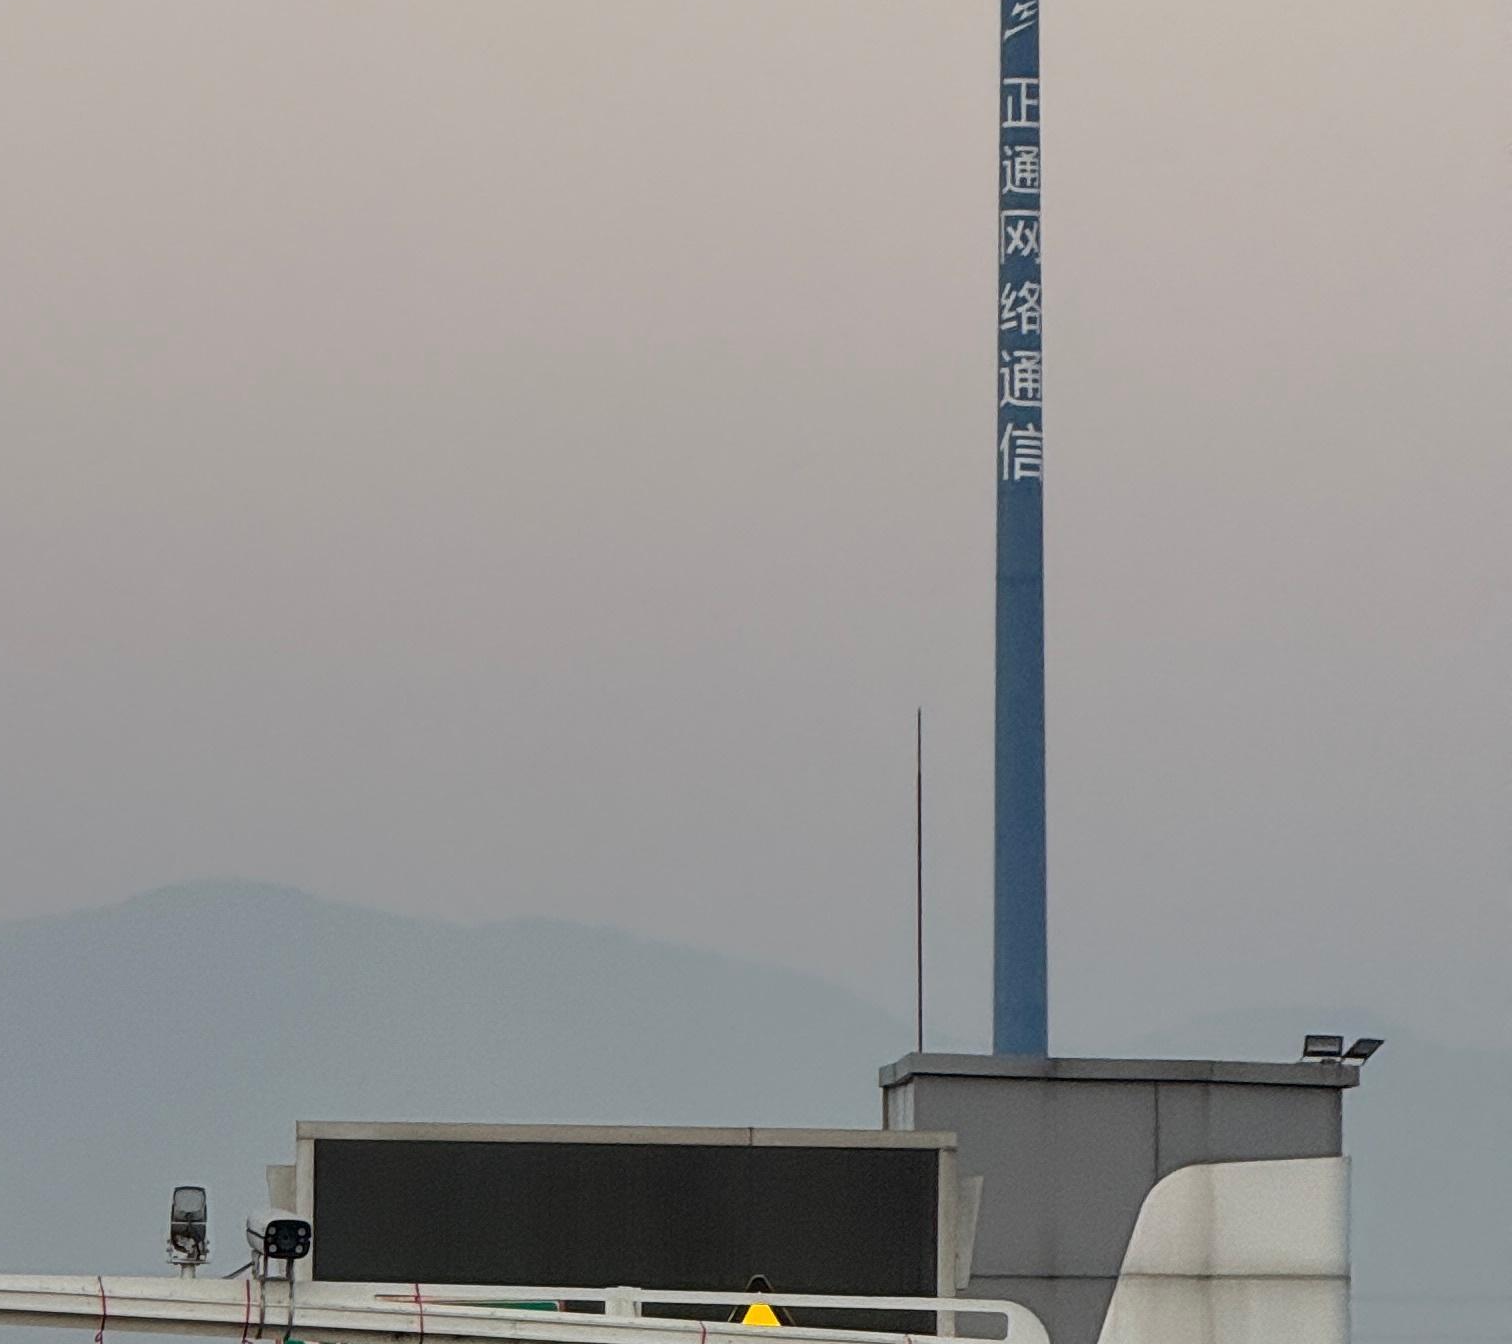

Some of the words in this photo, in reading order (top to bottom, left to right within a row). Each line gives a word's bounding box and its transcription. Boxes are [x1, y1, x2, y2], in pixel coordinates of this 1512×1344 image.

[1000, 78, 1044, 481] 正通网络通信
